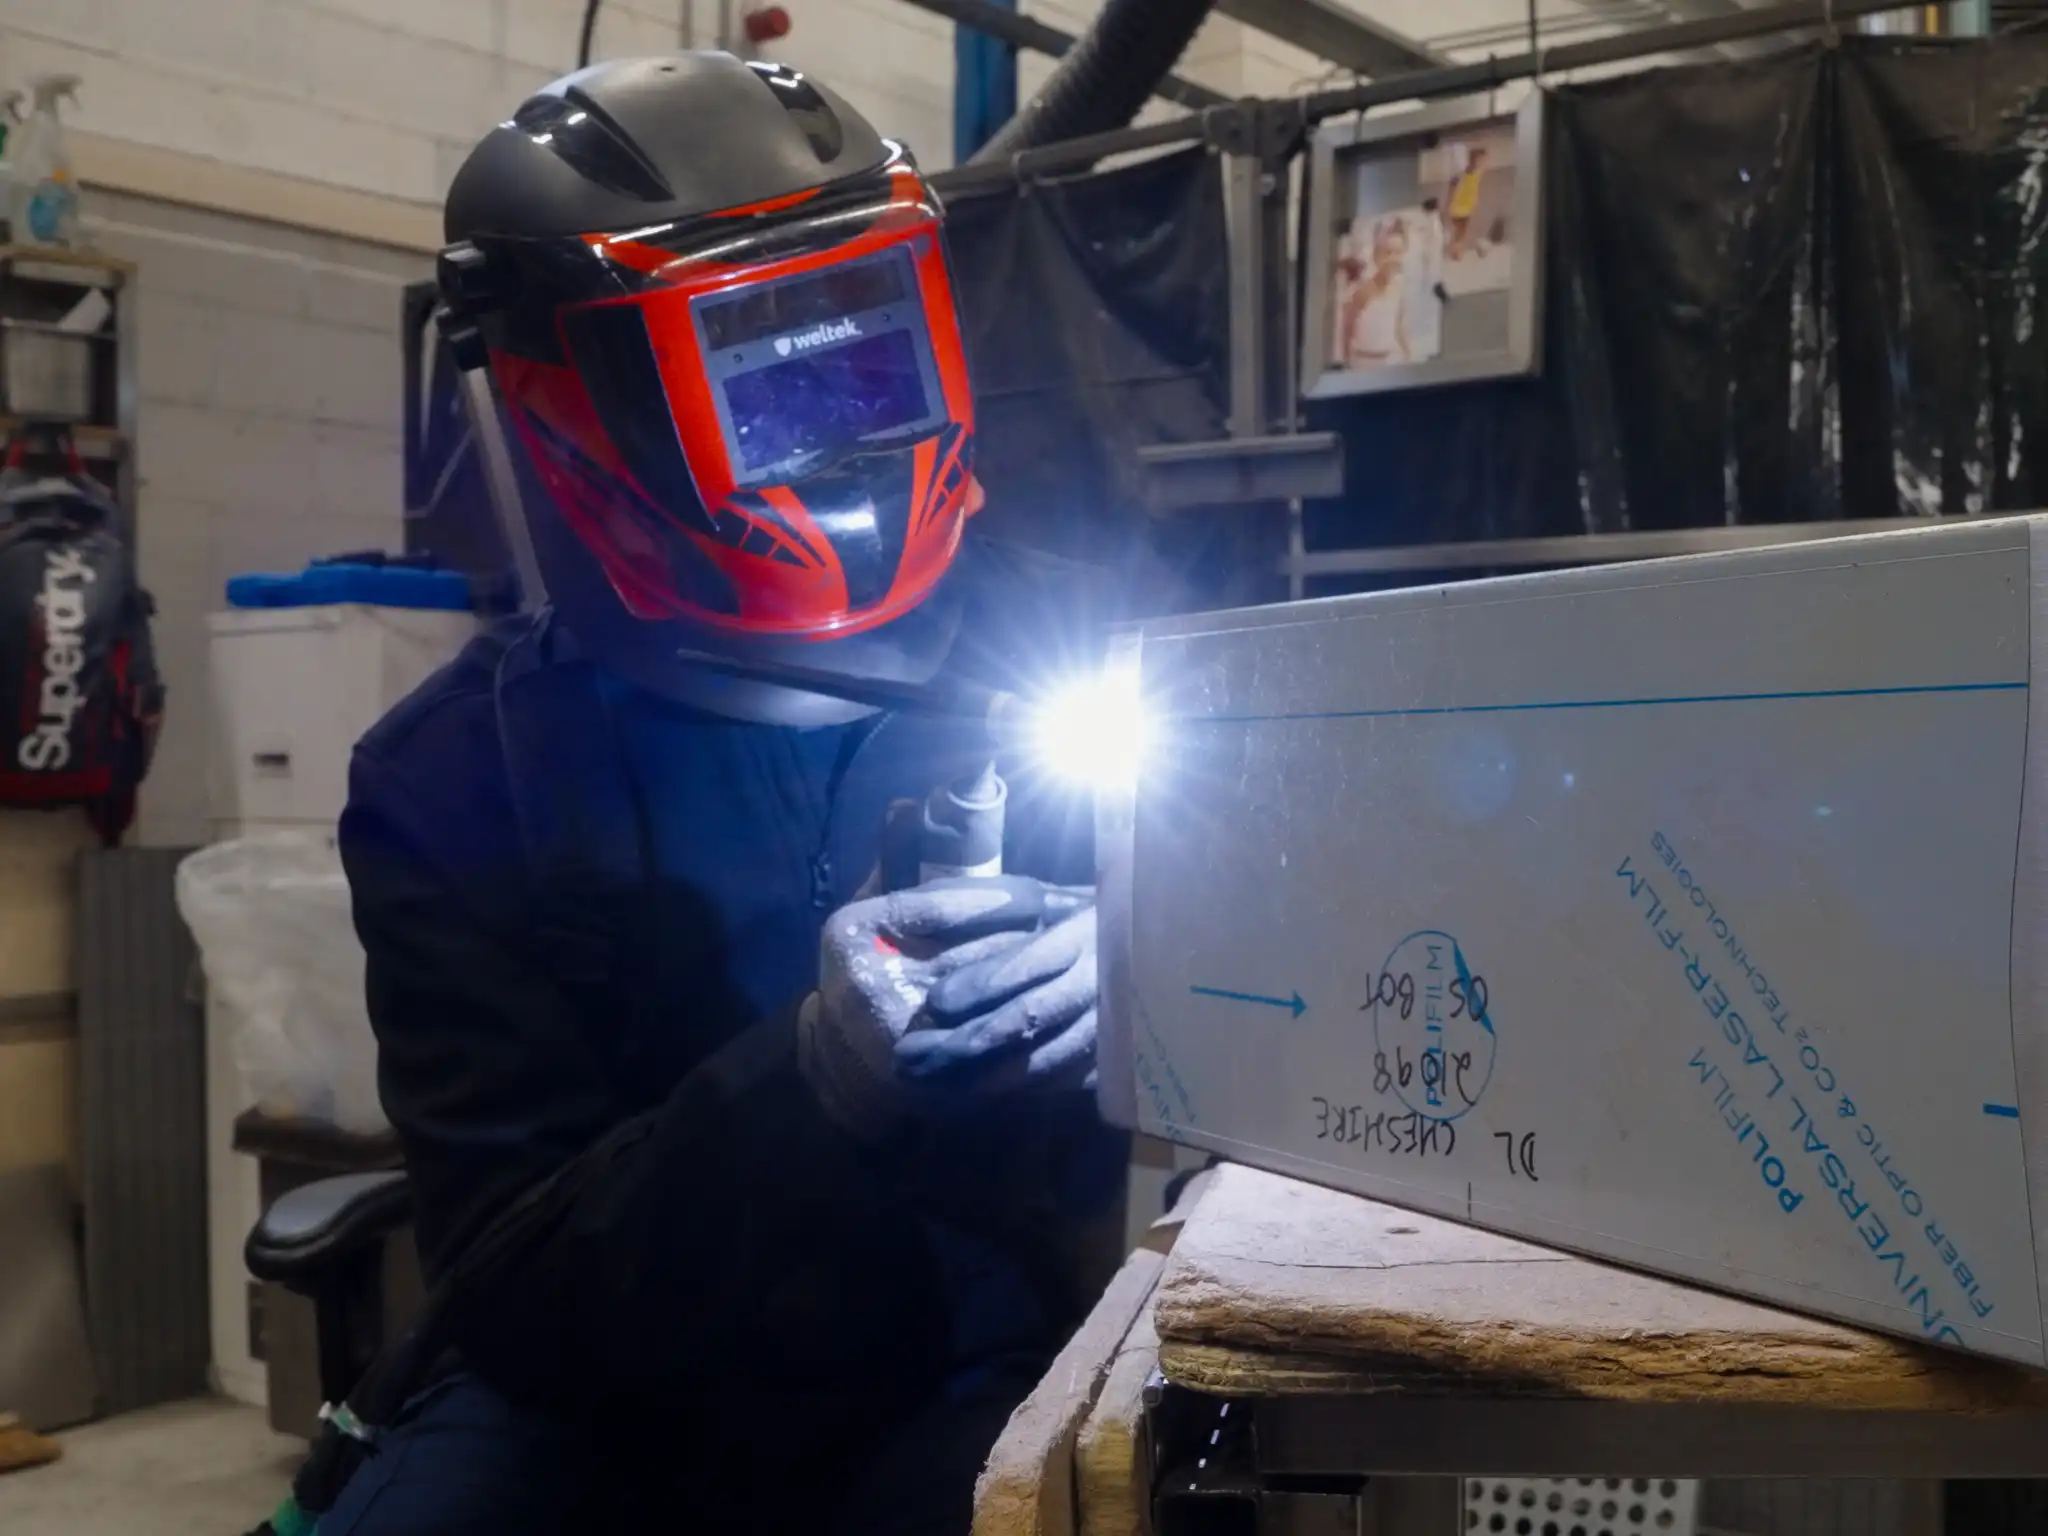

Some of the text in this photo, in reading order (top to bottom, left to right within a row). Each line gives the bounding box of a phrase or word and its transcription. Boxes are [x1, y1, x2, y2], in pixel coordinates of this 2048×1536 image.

[1615, 855, 1786, 1100] LASER-FILM
[1650, 829, 1789, 1036] TECHNOLOGIES
[1360, 972, 1415, 1020] BOT
[1425, 944, 1443, 1107] POLIFILM
[1312, 1097, 1539, 1182] DL CHESHIRE
[1688, 1046, 1805, 1216] POLIFILM
[1836, 1095, 1857, 1119] &
[1855, 1122, 1924, 1219] OPTIC
[1924, 1220, 1994, 1319] FIBER
